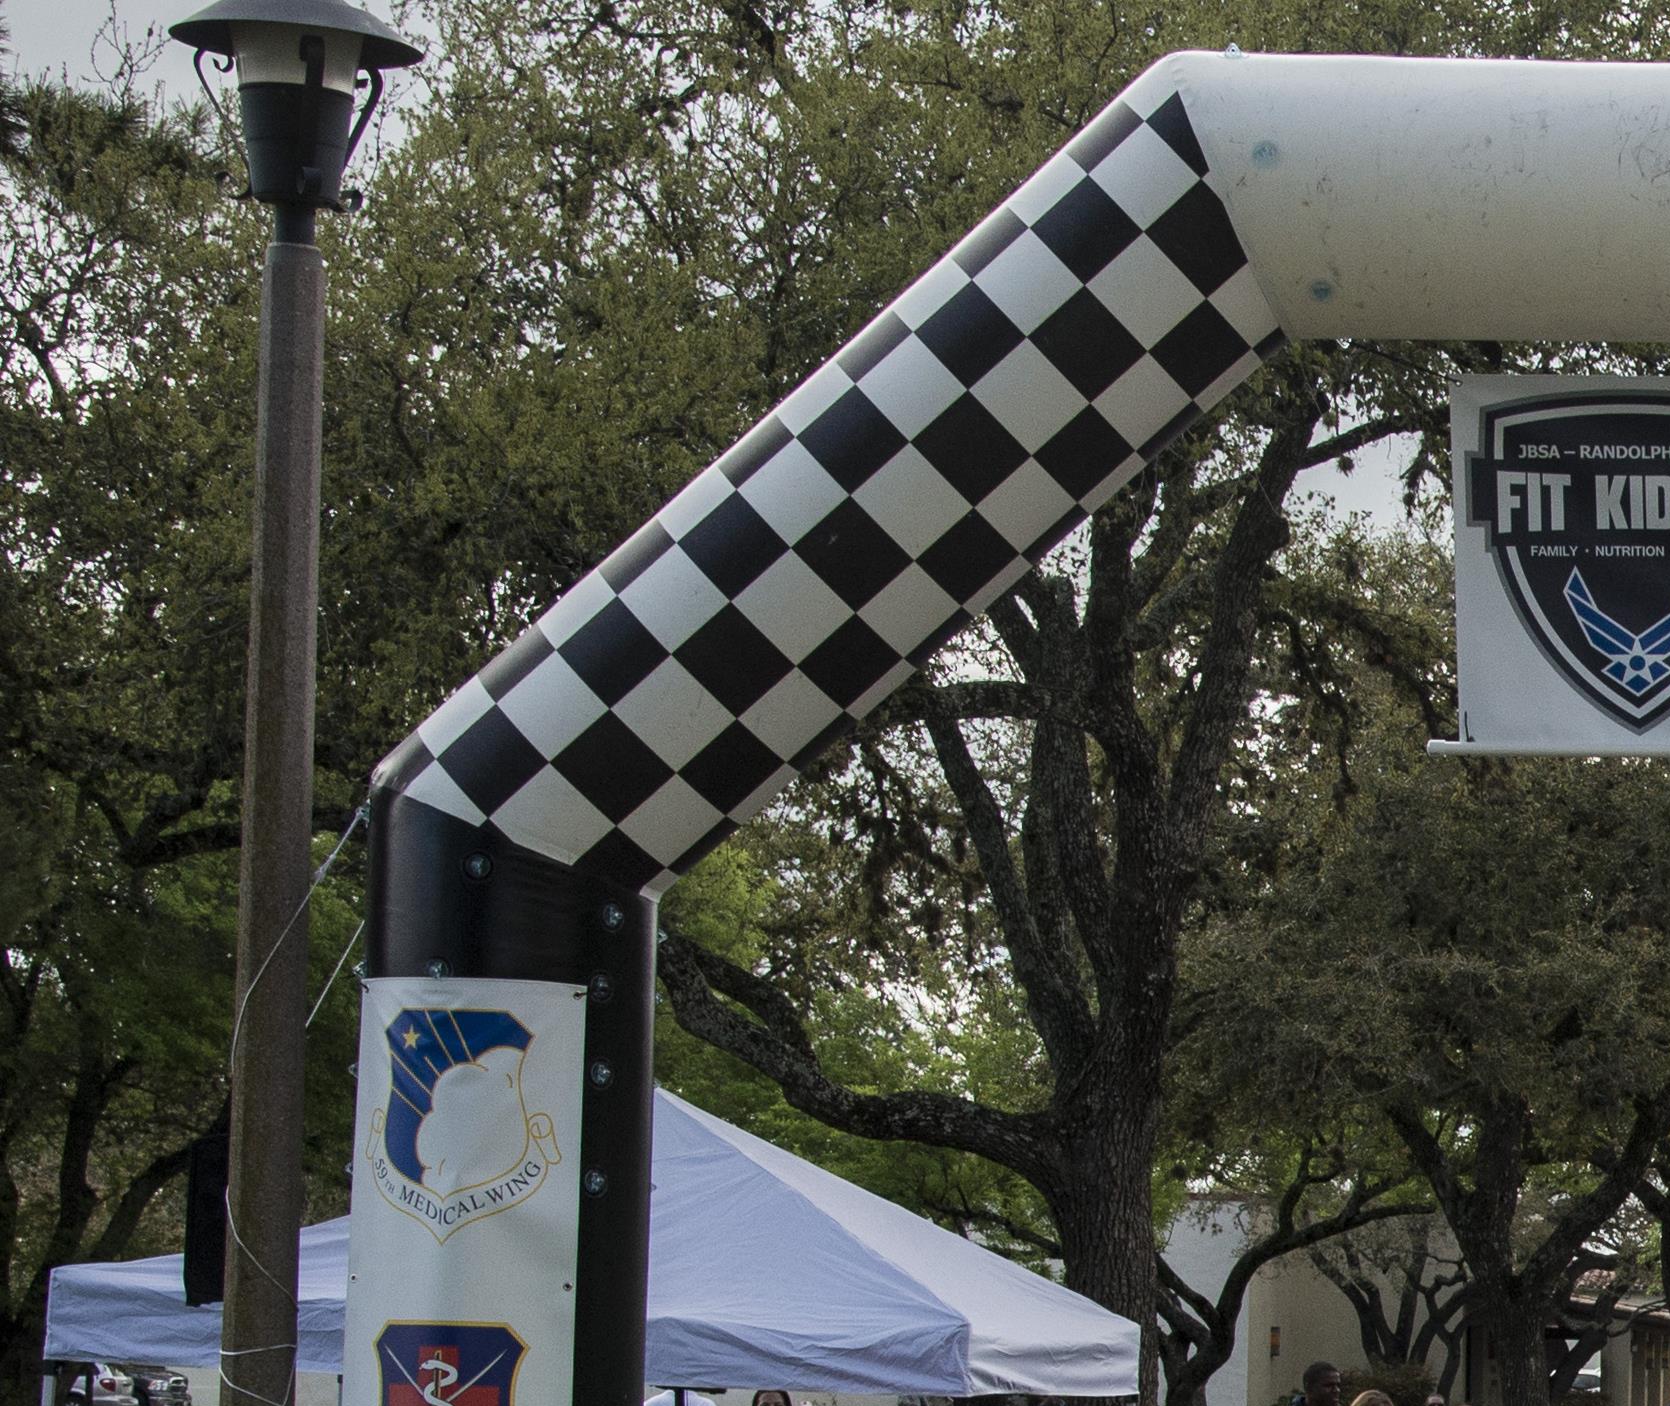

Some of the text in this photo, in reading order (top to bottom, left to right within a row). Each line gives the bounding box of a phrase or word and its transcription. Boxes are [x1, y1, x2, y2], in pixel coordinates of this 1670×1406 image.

[1518, 444, 1561, 460] JBSA
[1497, 470, 1571, 534] FIT
[1530, 545, 1578, 557] FAMILY
[1595, 545, 1666, 557] NUTRITION
[399, 1184, 486, 1226] MEDICAL
[484, 1160, 542, 1206] WING
